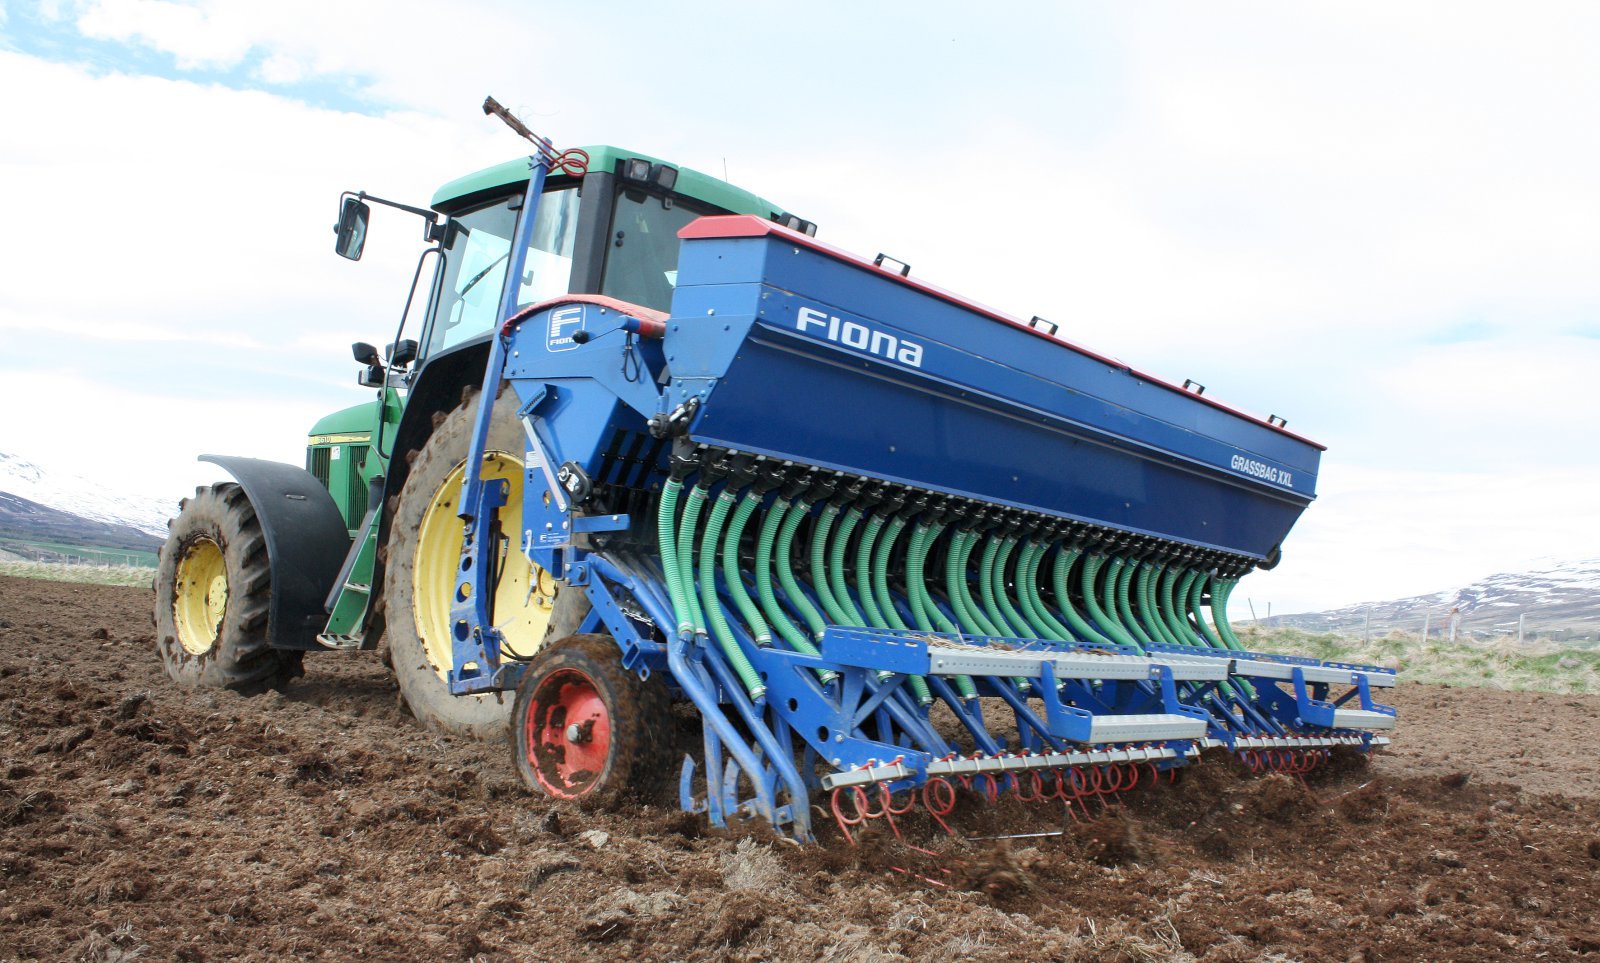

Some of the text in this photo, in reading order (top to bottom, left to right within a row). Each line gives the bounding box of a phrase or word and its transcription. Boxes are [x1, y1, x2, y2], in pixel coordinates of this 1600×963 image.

[550, 307, 581, 338] F
[1231, 455, 1293, 487] GRASSBAG XXL
